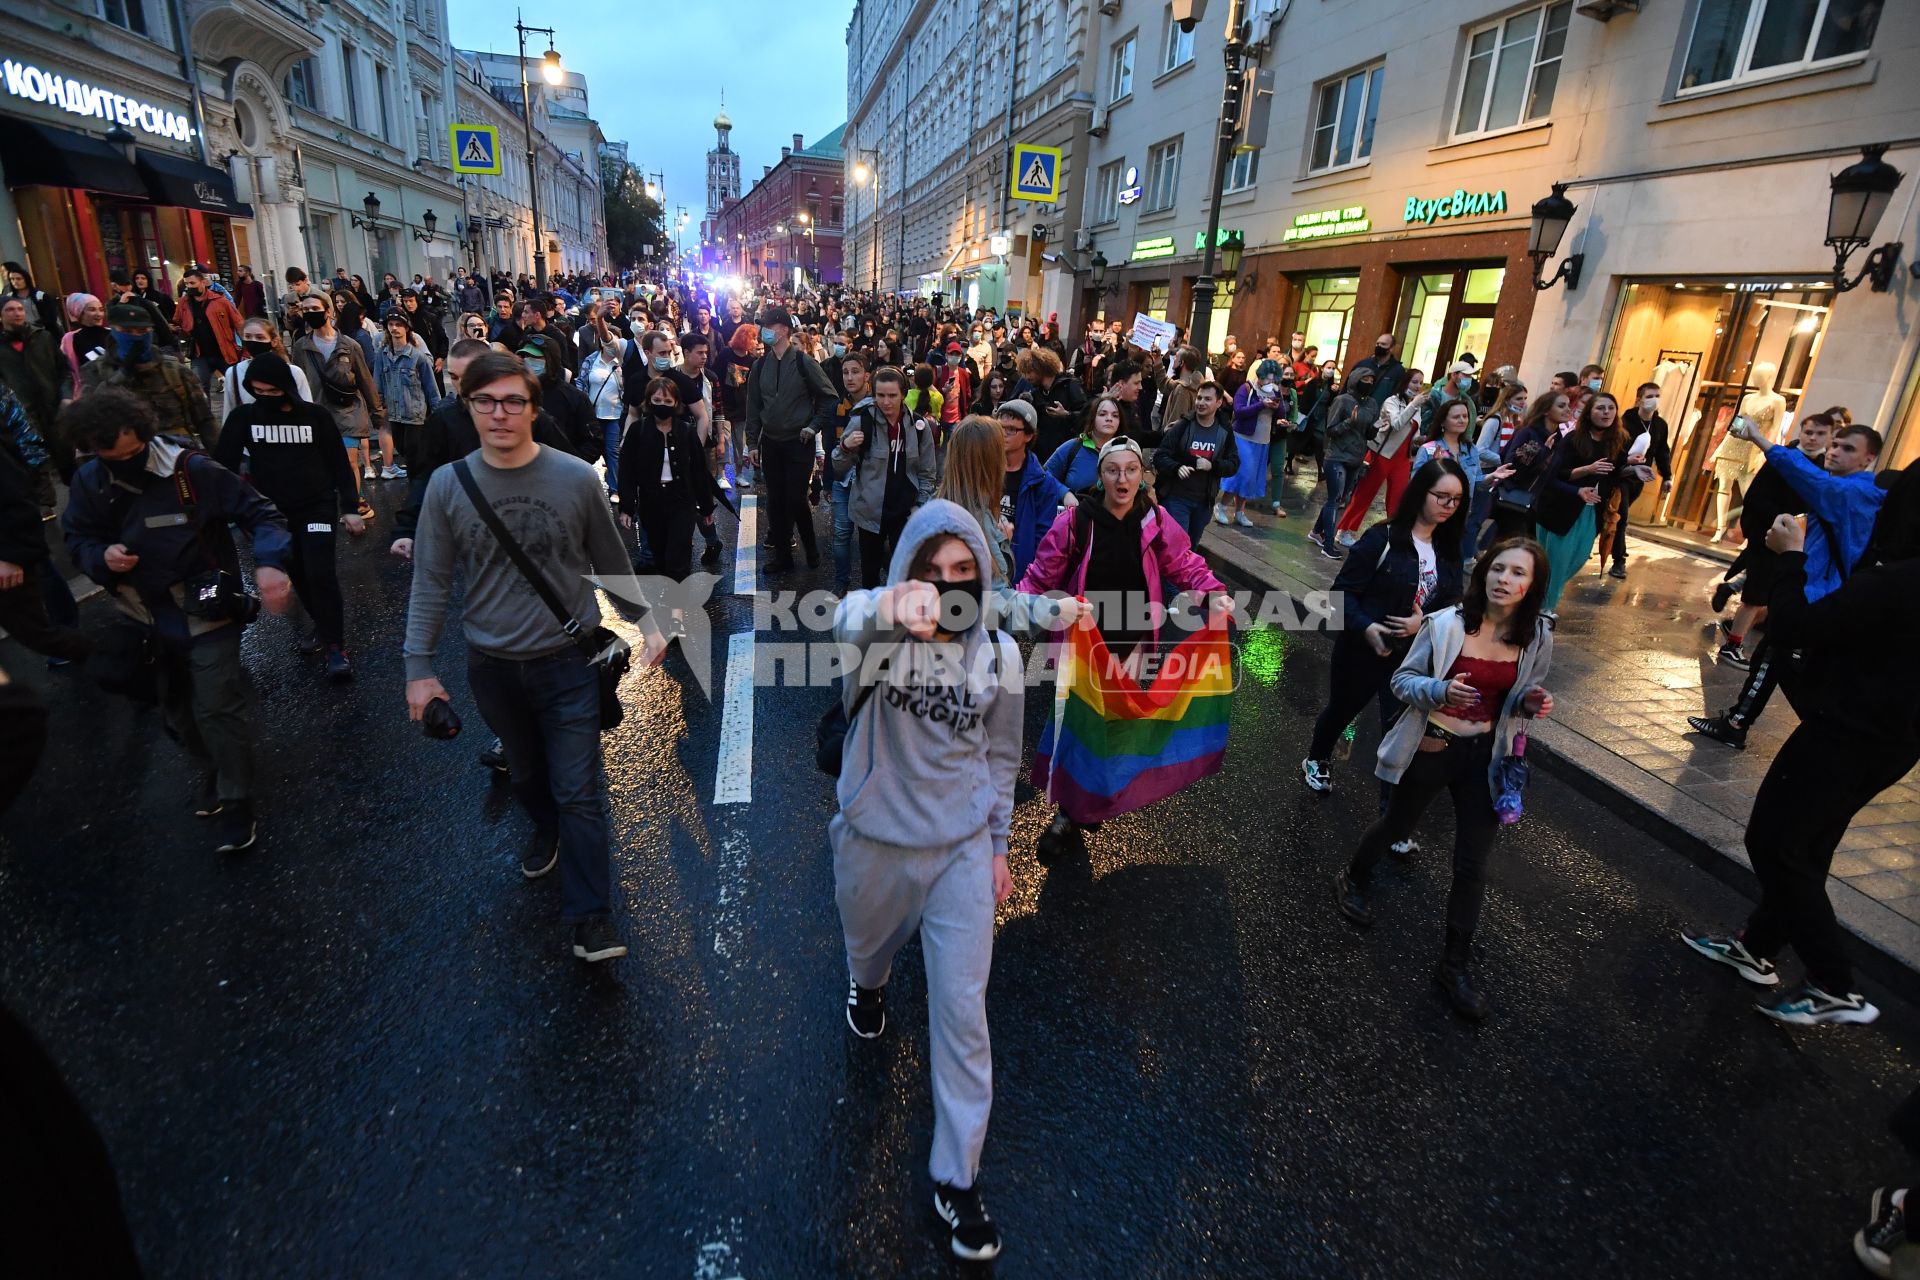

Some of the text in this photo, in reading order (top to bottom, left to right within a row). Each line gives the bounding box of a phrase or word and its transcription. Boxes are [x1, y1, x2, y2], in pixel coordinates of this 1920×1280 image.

[3, 58, 191, 142] КОНДИТЕРСКАЯ
[1403, 189, 1504, 224] ВкусВилл
[251, 425, 313, 443] PUMA
[307, 523, 332, 532] PUMA
